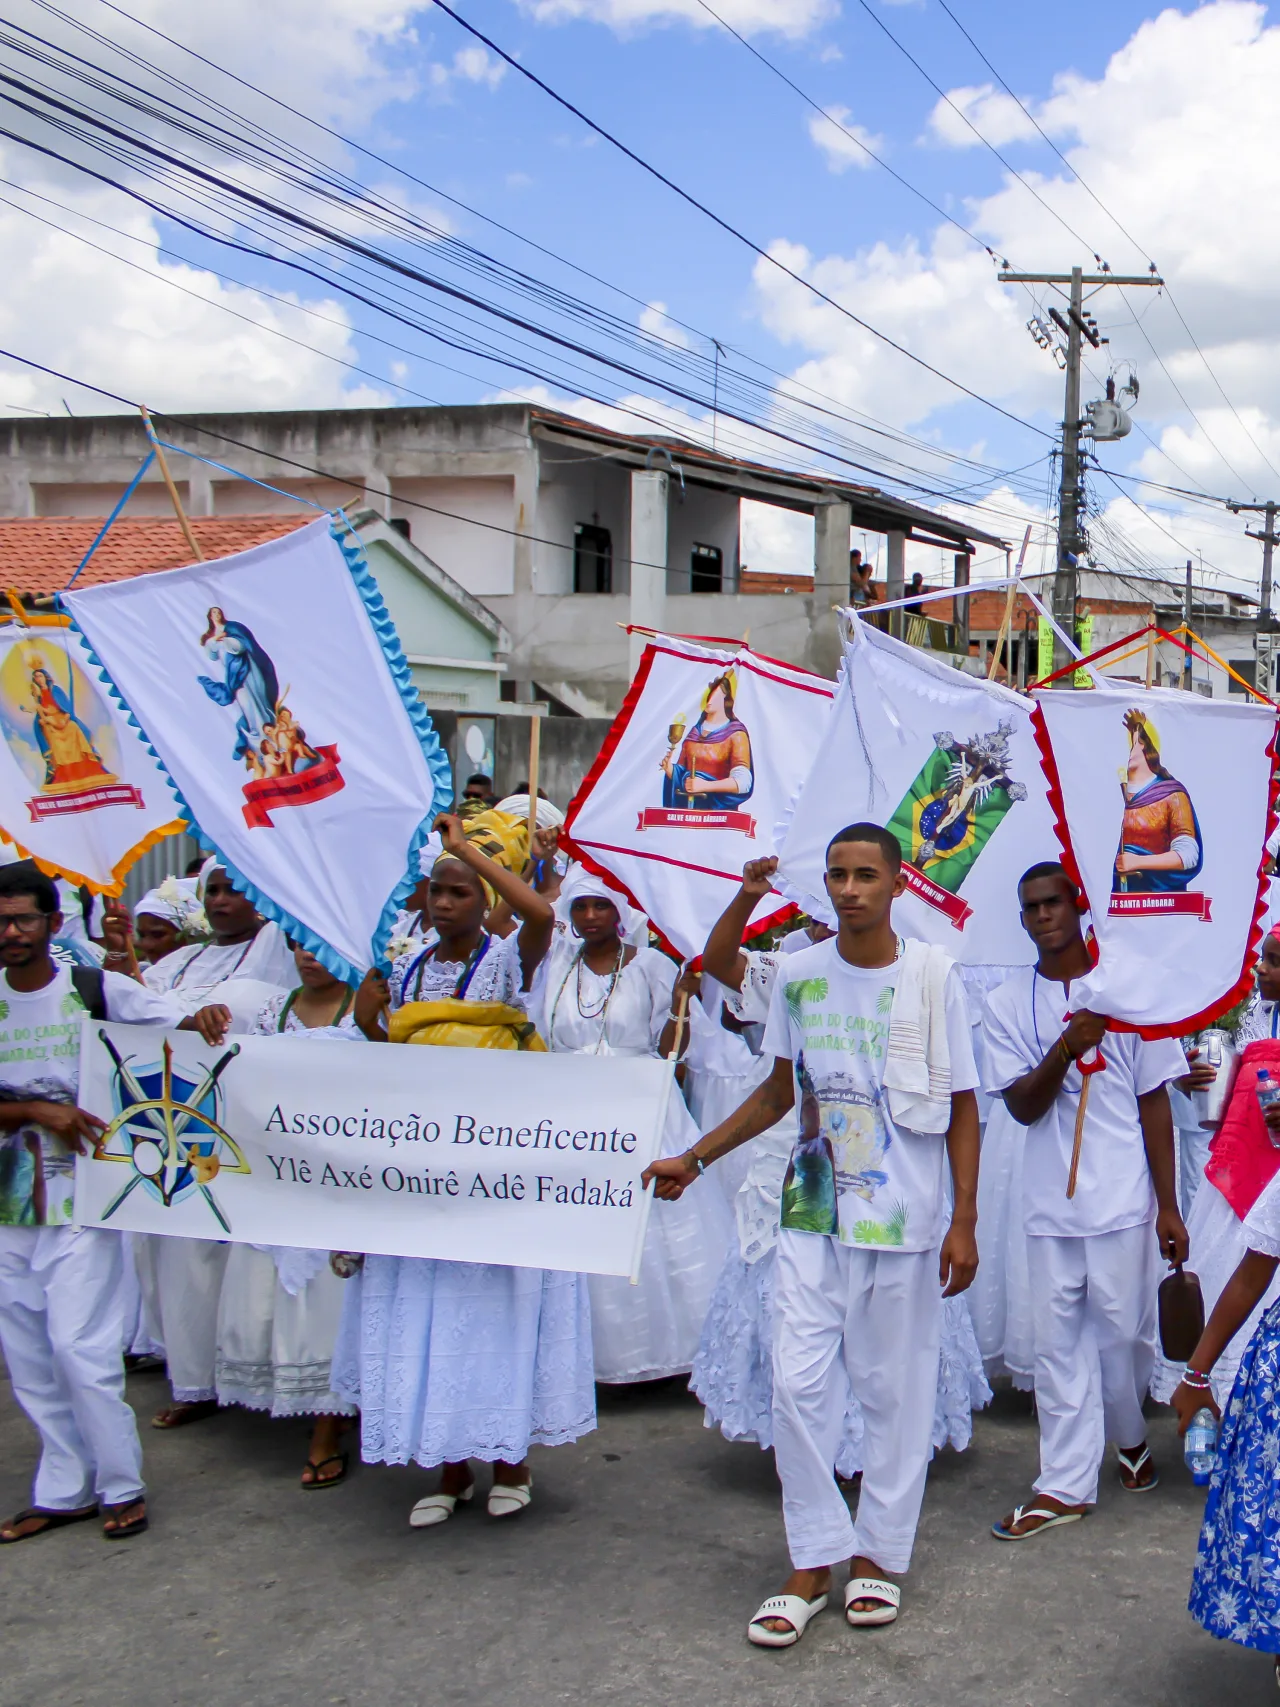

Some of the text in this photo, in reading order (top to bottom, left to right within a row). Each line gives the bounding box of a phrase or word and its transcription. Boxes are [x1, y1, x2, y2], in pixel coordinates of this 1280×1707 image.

[667, 813, 684, 821] SALVE
[685, 814, 702, 822] SANTA
[913, 878, 922, 888] DO
[921, 883, 946, 903] BONFIM!
[1120, 899, 1140, 908] SANTA
[1142, 898, 1175, 908] BÁRBARA!
[827, 1013, 841, 1027] DO
[14, 1028, 31, 1040] DO
[265, 1104, 637, 1154] Associação Beneficente
[265, 1154, 634, 1208] Ylê Axé Onirê Adê Fadaká
